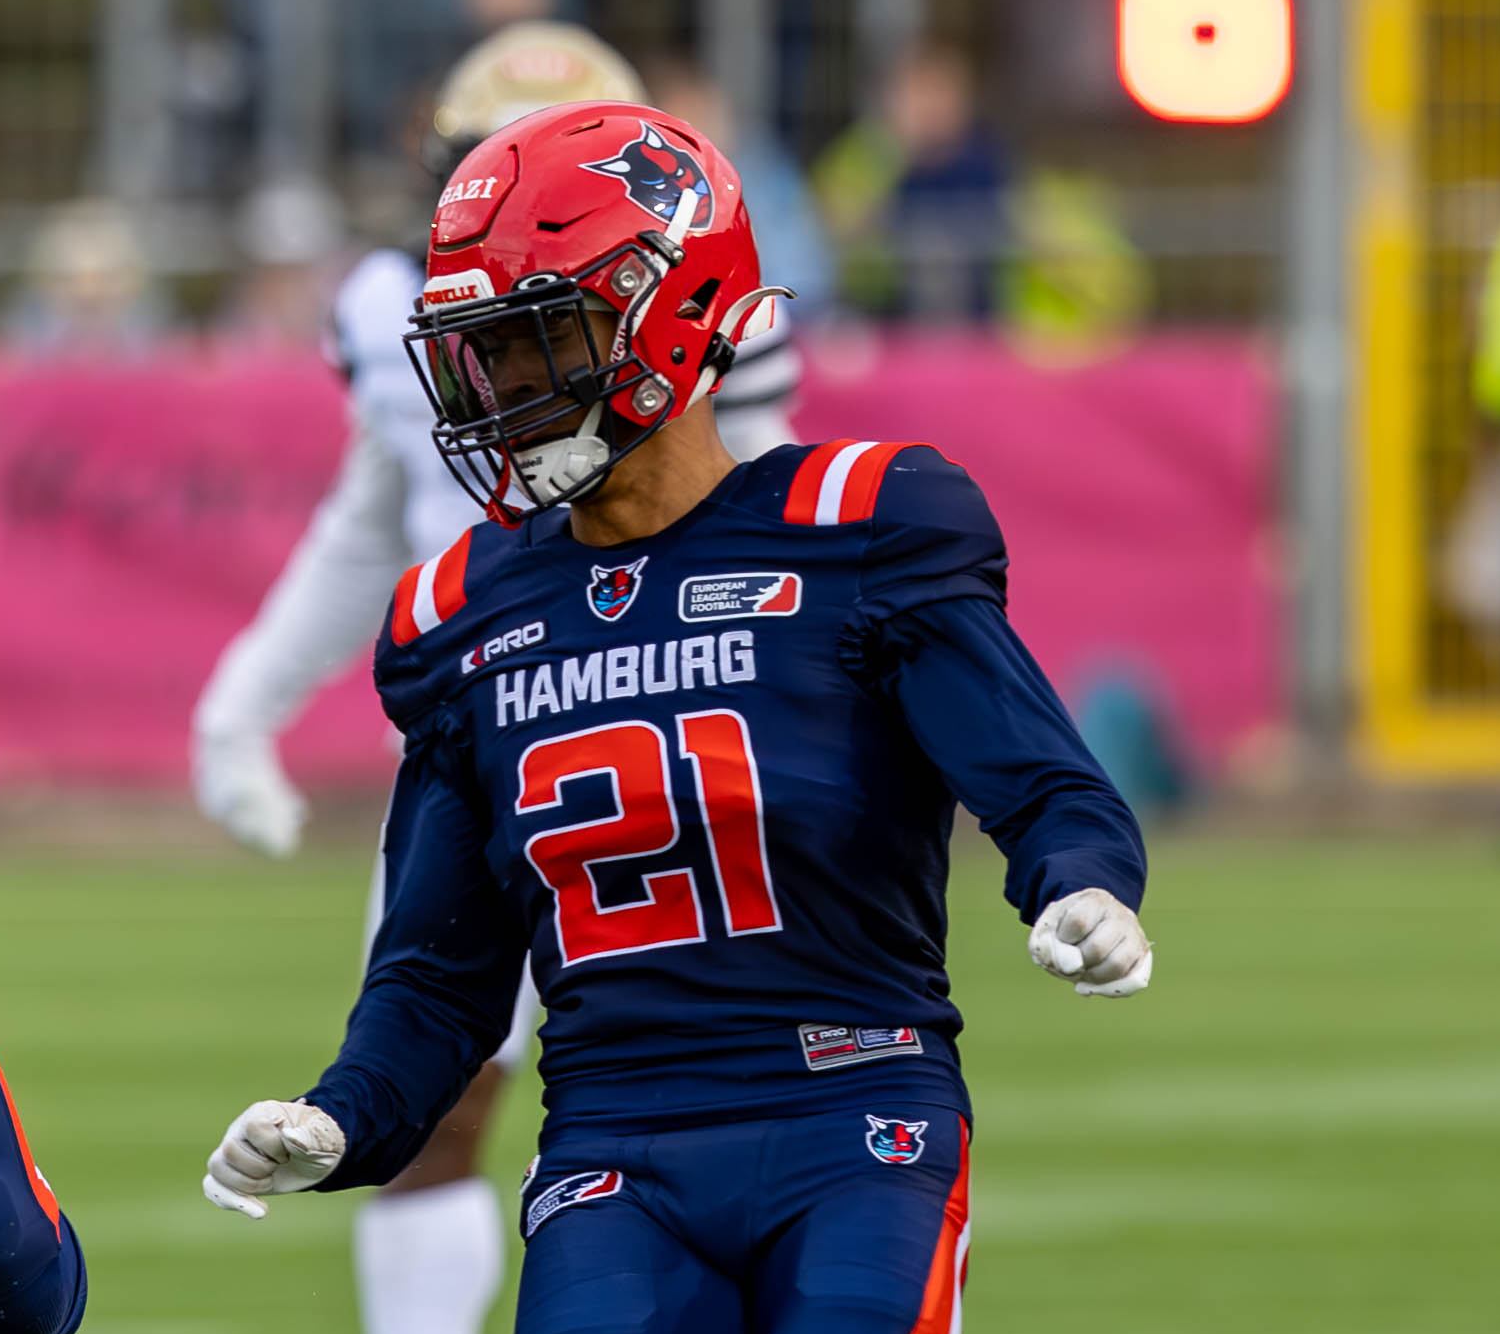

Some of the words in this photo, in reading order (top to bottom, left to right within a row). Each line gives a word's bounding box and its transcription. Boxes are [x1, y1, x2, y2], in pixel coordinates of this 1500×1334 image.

[691, 581, 747, 594] EUROPEAN
[691, 592, 730, 603] LEAGUE
[690, 600, 742, 613] FOOTBALL
[496, 630, 757, 727] HAMBURG
[513, 707, 784, 969] 21
